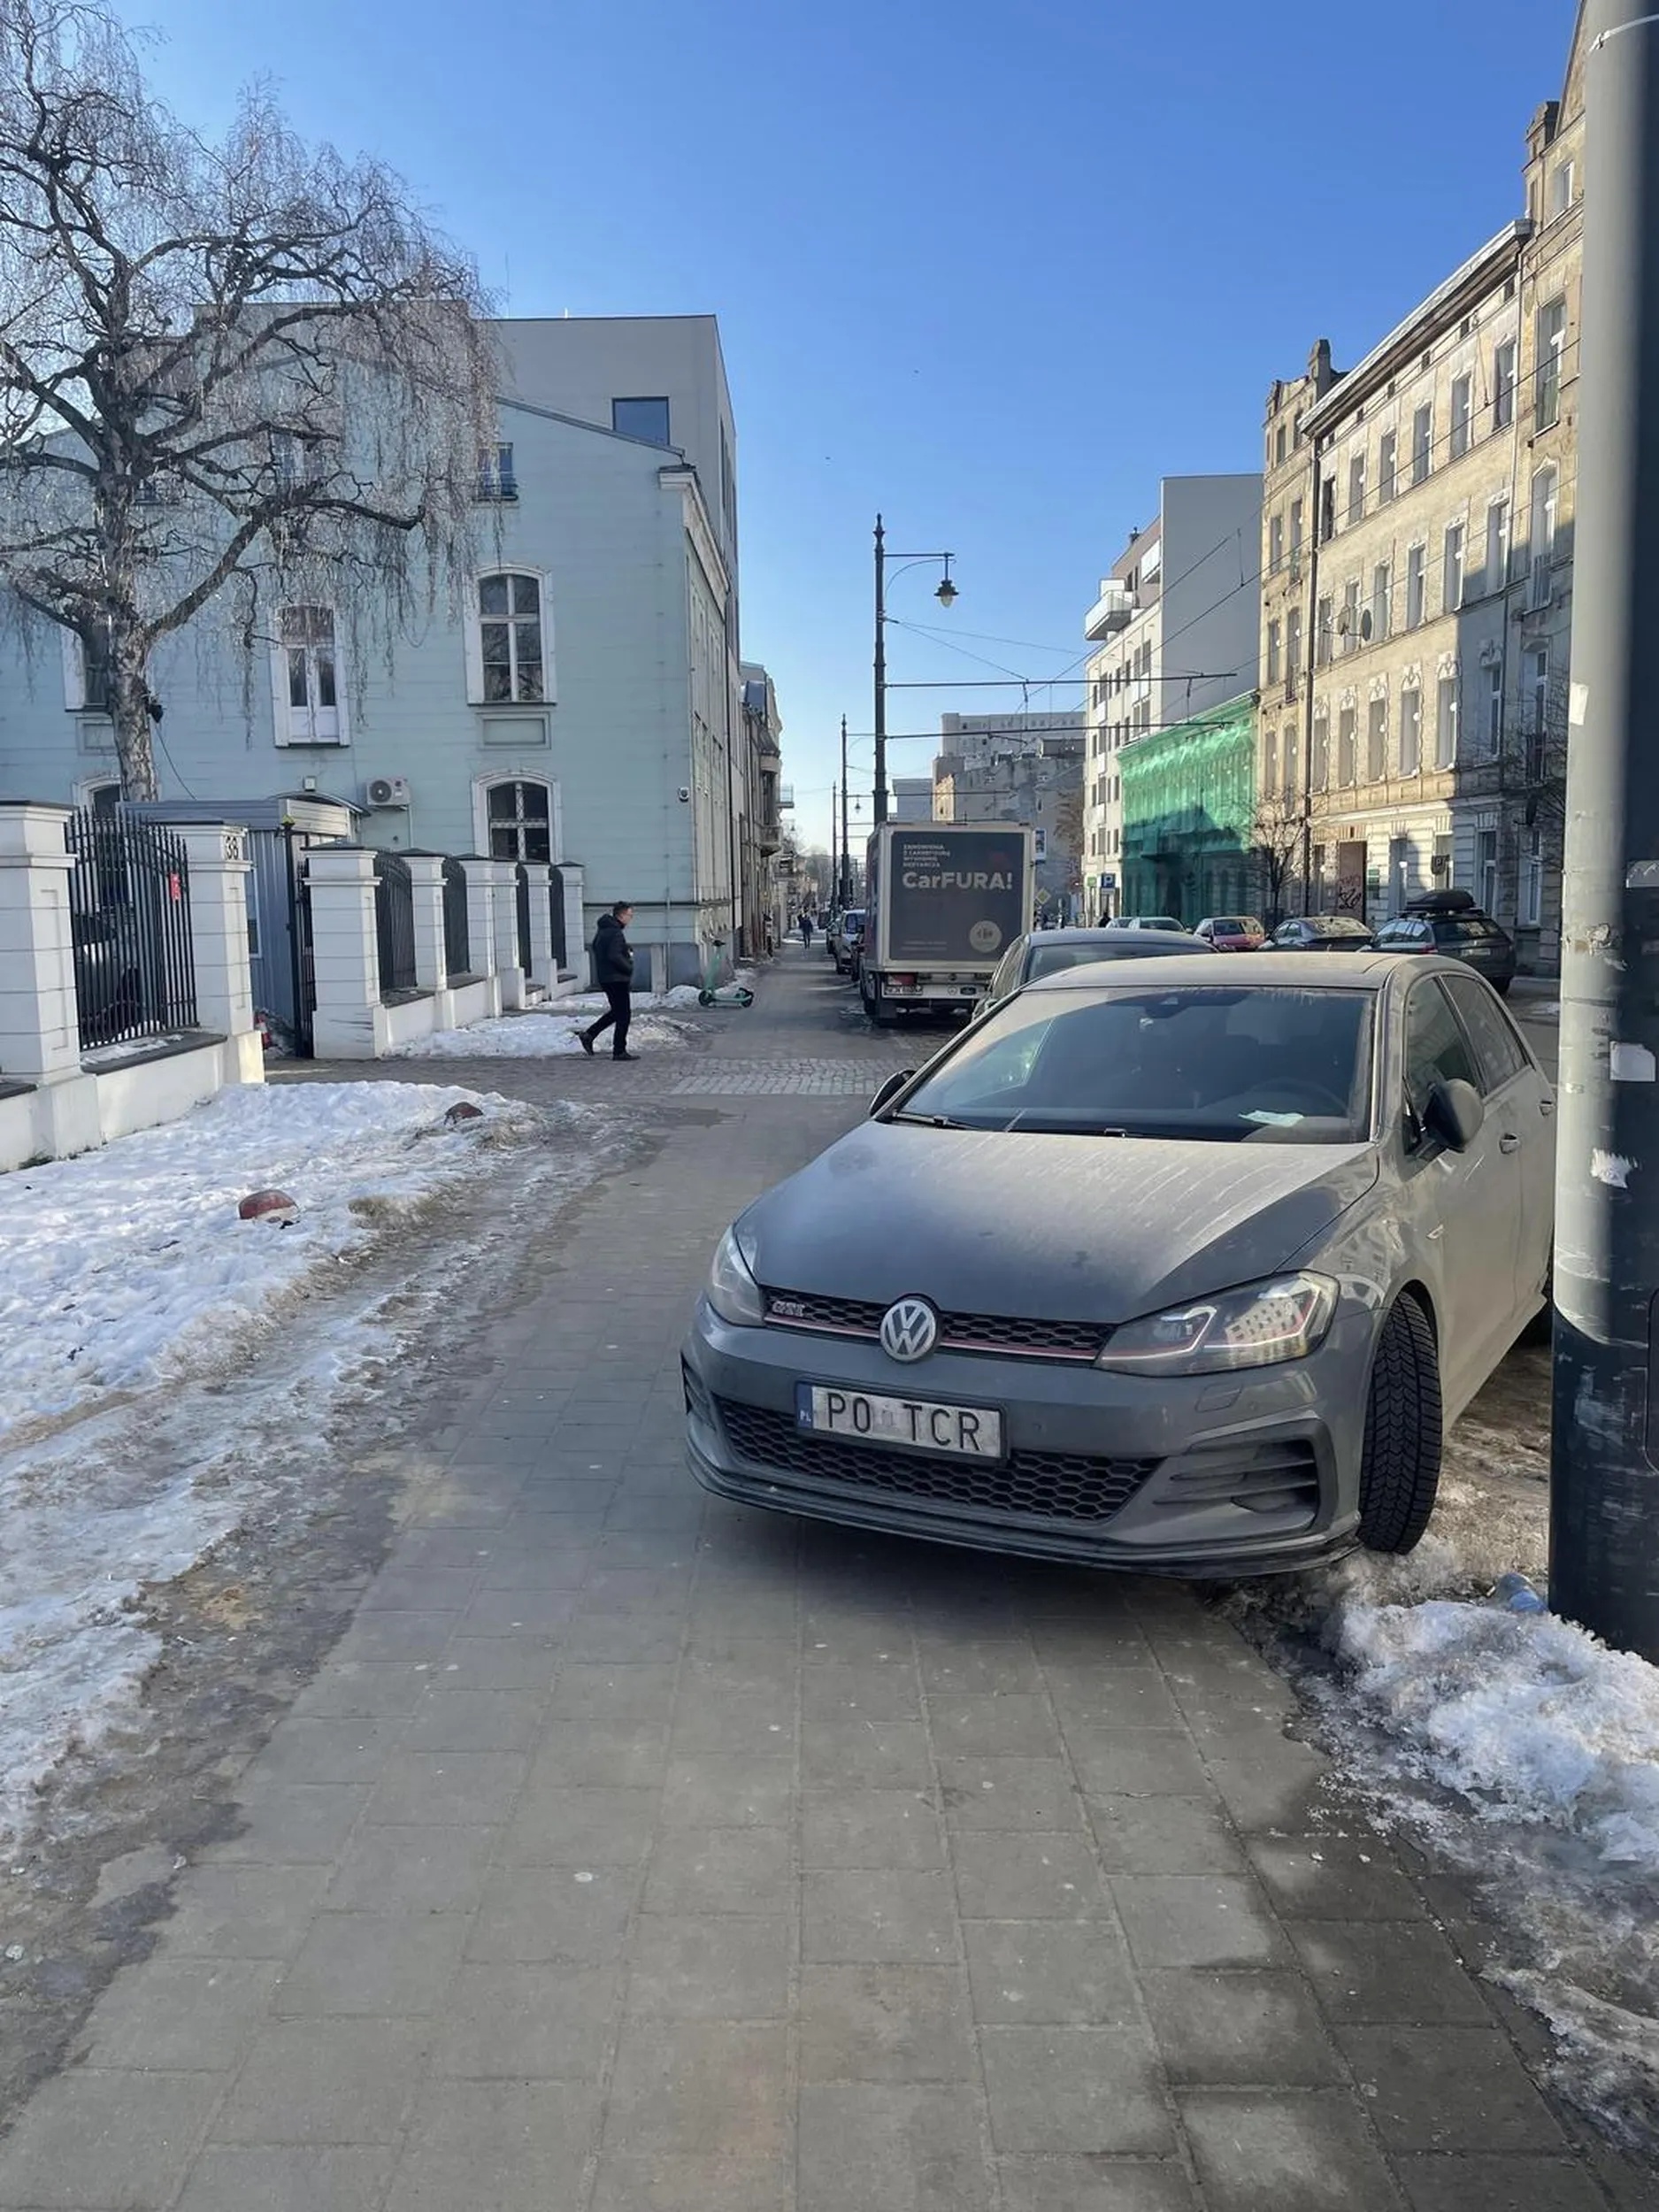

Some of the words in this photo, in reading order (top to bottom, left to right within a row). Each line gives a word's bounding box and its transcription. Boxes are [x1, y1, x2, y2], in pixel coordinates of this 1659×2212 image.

[902, 872, 1012, 889] CarFURA!
[799, 1409, 811, 1422] PL
[826, 1393, 871, 1433] PO
[902, 1403, 981, 1451] TCR
